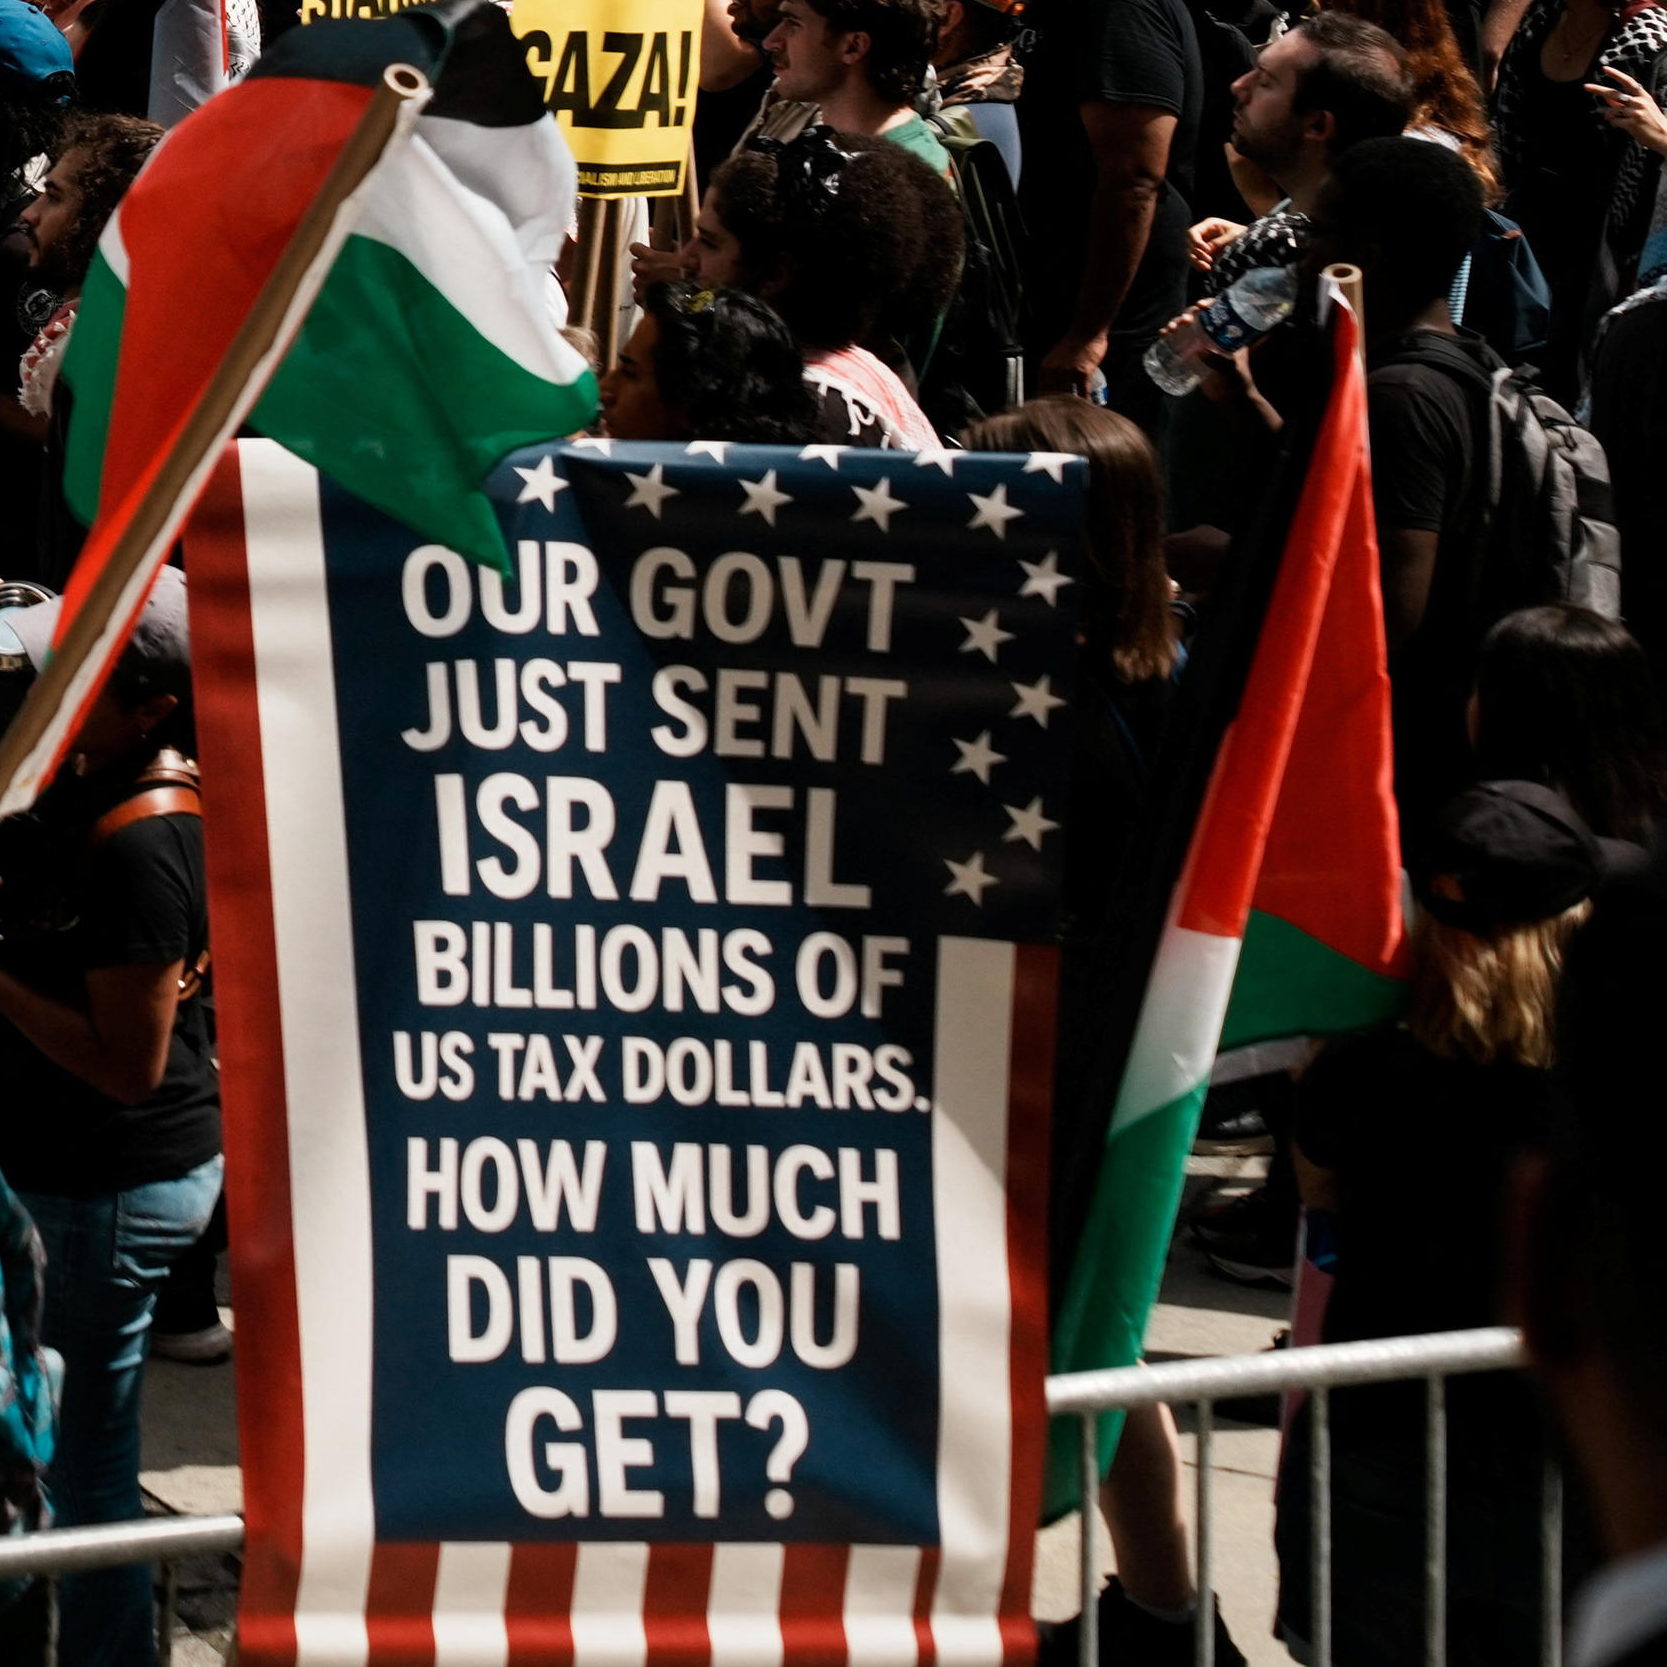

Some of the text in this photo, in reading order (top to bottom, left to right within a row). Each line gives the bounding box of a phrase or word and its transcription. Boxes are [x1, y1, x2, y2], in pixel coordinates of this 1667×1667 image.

[401, 539, 917, 654] OUR GOVT
[401, 661, 908, 766] JUST SENT
[434, 772, 873, 909] ISRAEL
[412, 919, 909, 1019] BILLIONS OF
[393, 1028, 933, 1114] US TAX DOLLARS.
[405, 1135, 901, 1242] HOW MUCH
[446, 1253, 861, 1369] DID YOU
[504, 1387, 810, 1521] GET?
